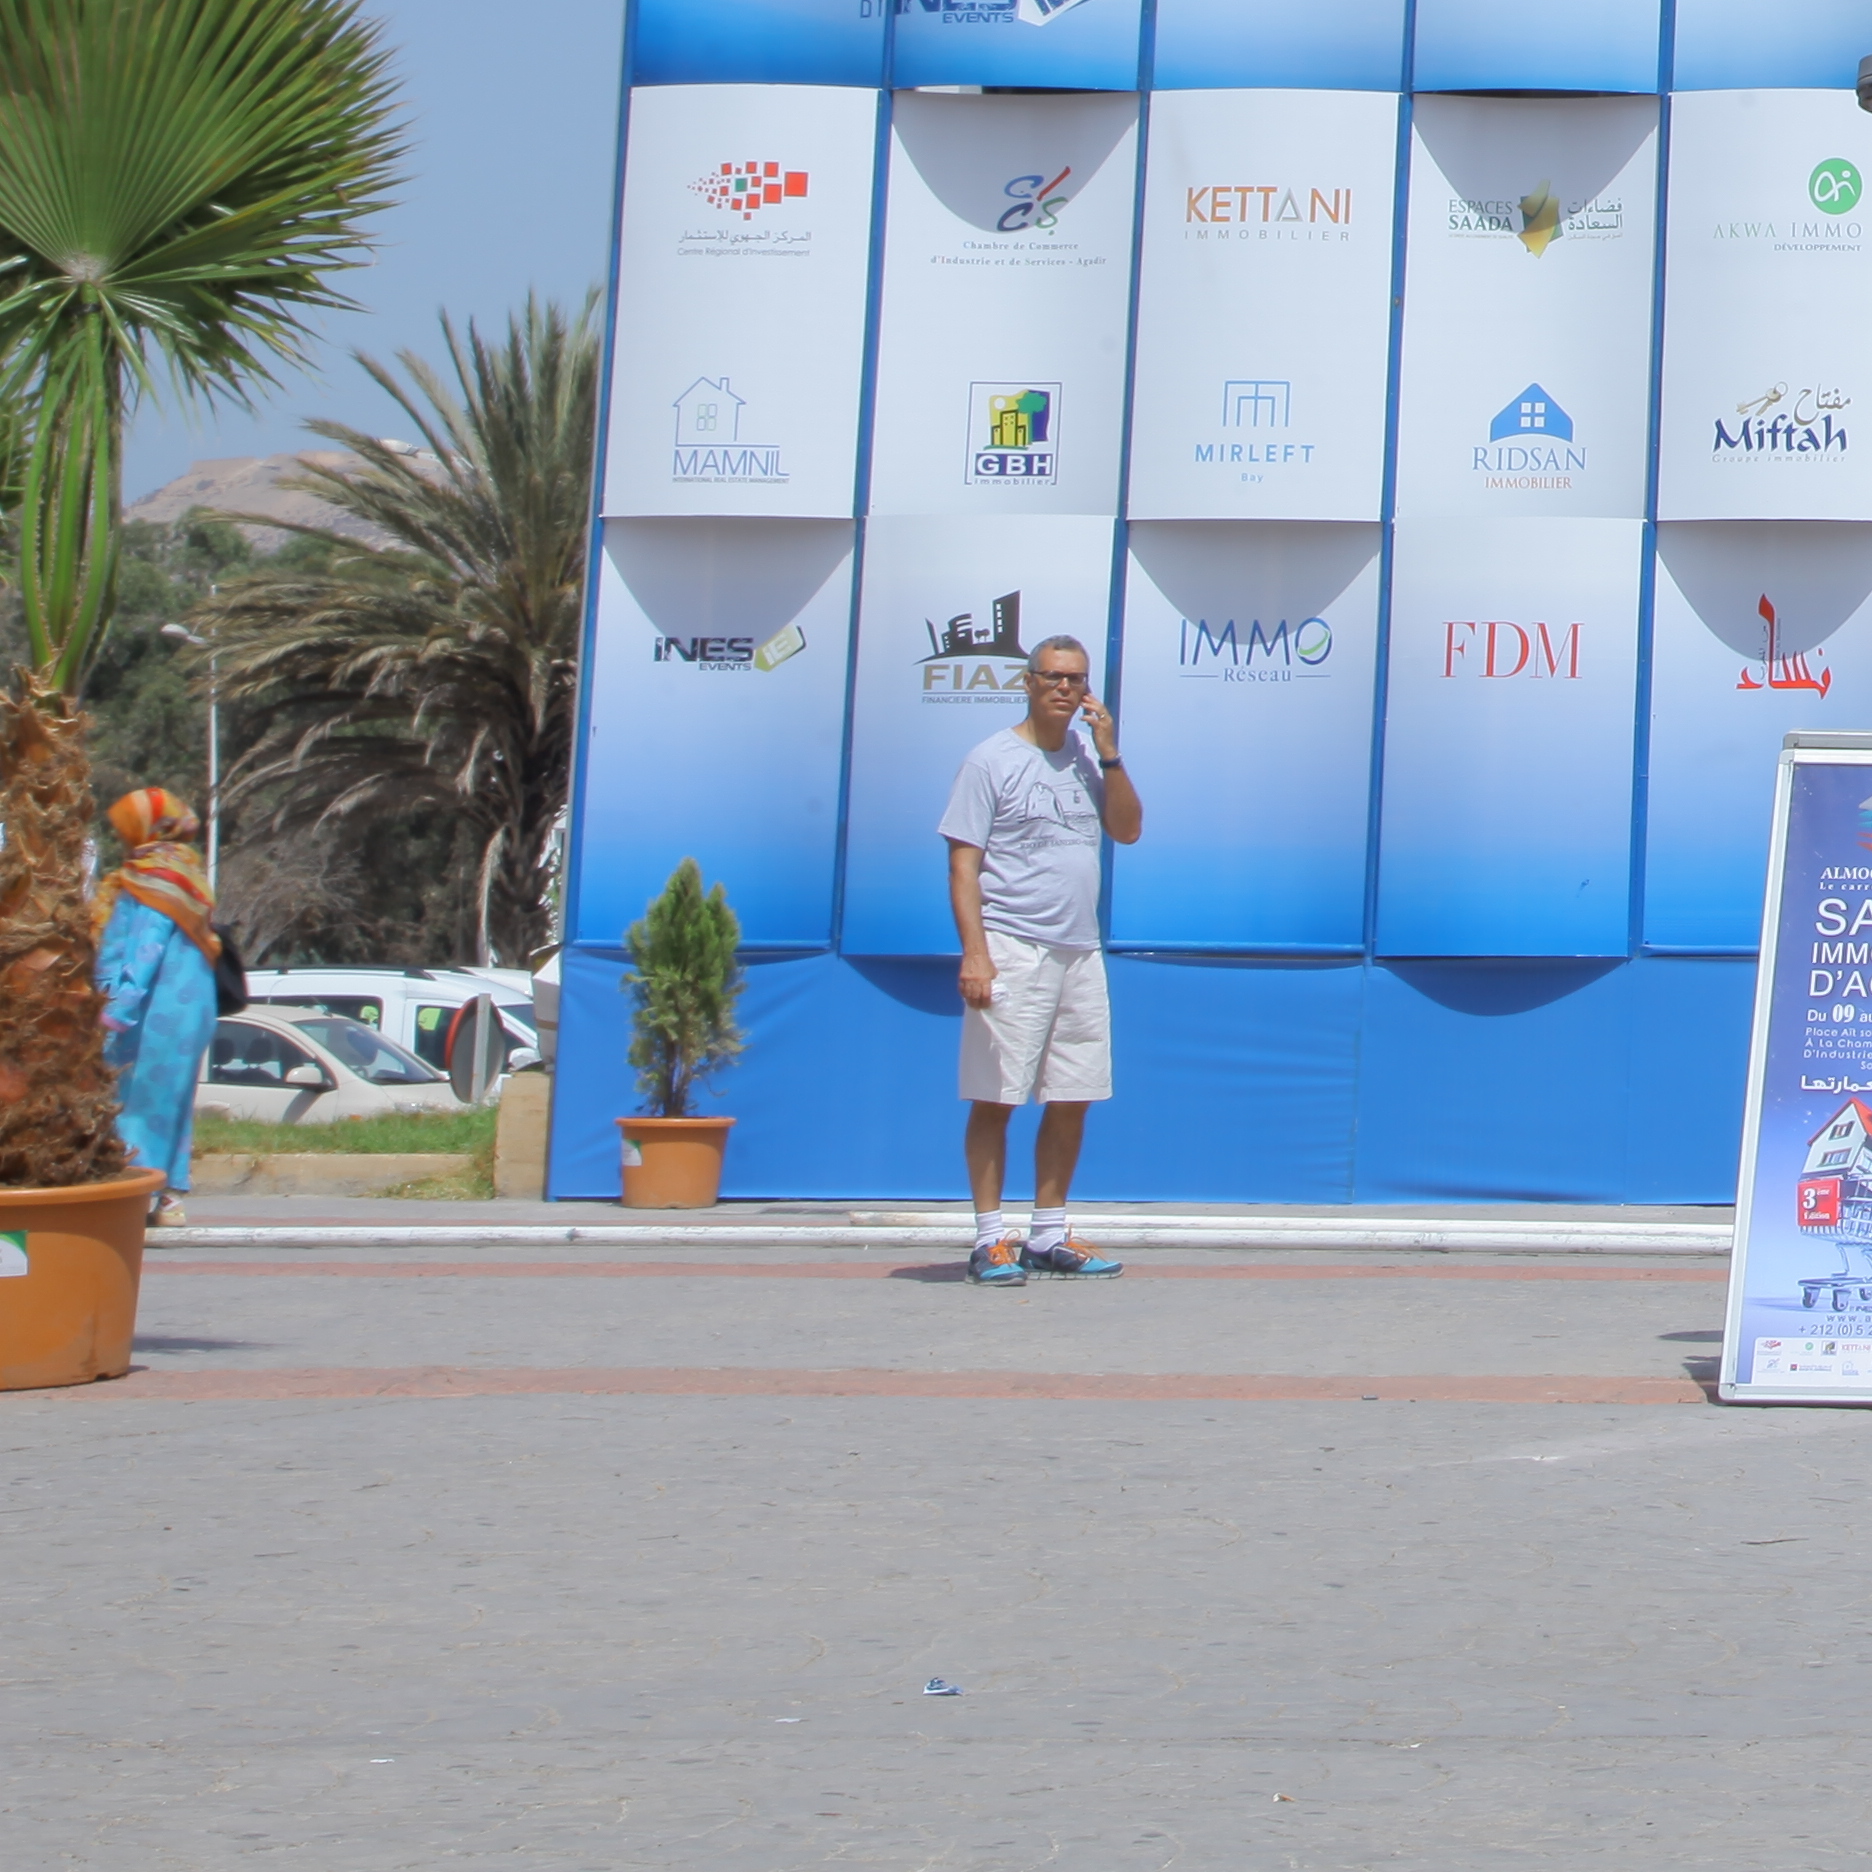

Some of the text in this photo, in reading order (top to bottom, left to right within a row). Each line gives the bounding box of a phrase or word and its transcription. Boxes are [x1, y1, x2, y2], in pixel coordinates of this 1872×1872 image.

[942, 11, 1014, 25] EVENTS
[1185, 186, 1351, 225] KETTANI
[1449, 199, 1513, 214] ESPACES
[1449, 215, 1513, 232] SAADA
[1713, 221, 1862, 239] AKWA IMMO
[1184, 230, 1351, 242] IMMOBILIER
[1713, 414, 1847, 453] Miftah
[673, 449, 790, 476] MAMNIL
[1195, 444, 1315, 465] MIRLEFT
[1472, 446, 1588, 473] RIDSAN
[975, 454, 1053, 476] GBH
[1240, 473, 1264, 483] Bay
[1484, 476, 1572, 490] IMMOBILIER
[654, 637, 753, 662] INES
[1179, 618, 1333, 666] IMMO
[1440, 622, 1585, 679] FDM
[699, 662, 751, 671] EVENTS
[1223, 666, 1292, 682] Réseau
[923, 663, 1028, 691] FIAZ
[1807, 1009, 1827, 1022] Du
[1832, 1004, 1855, 1024] 09
